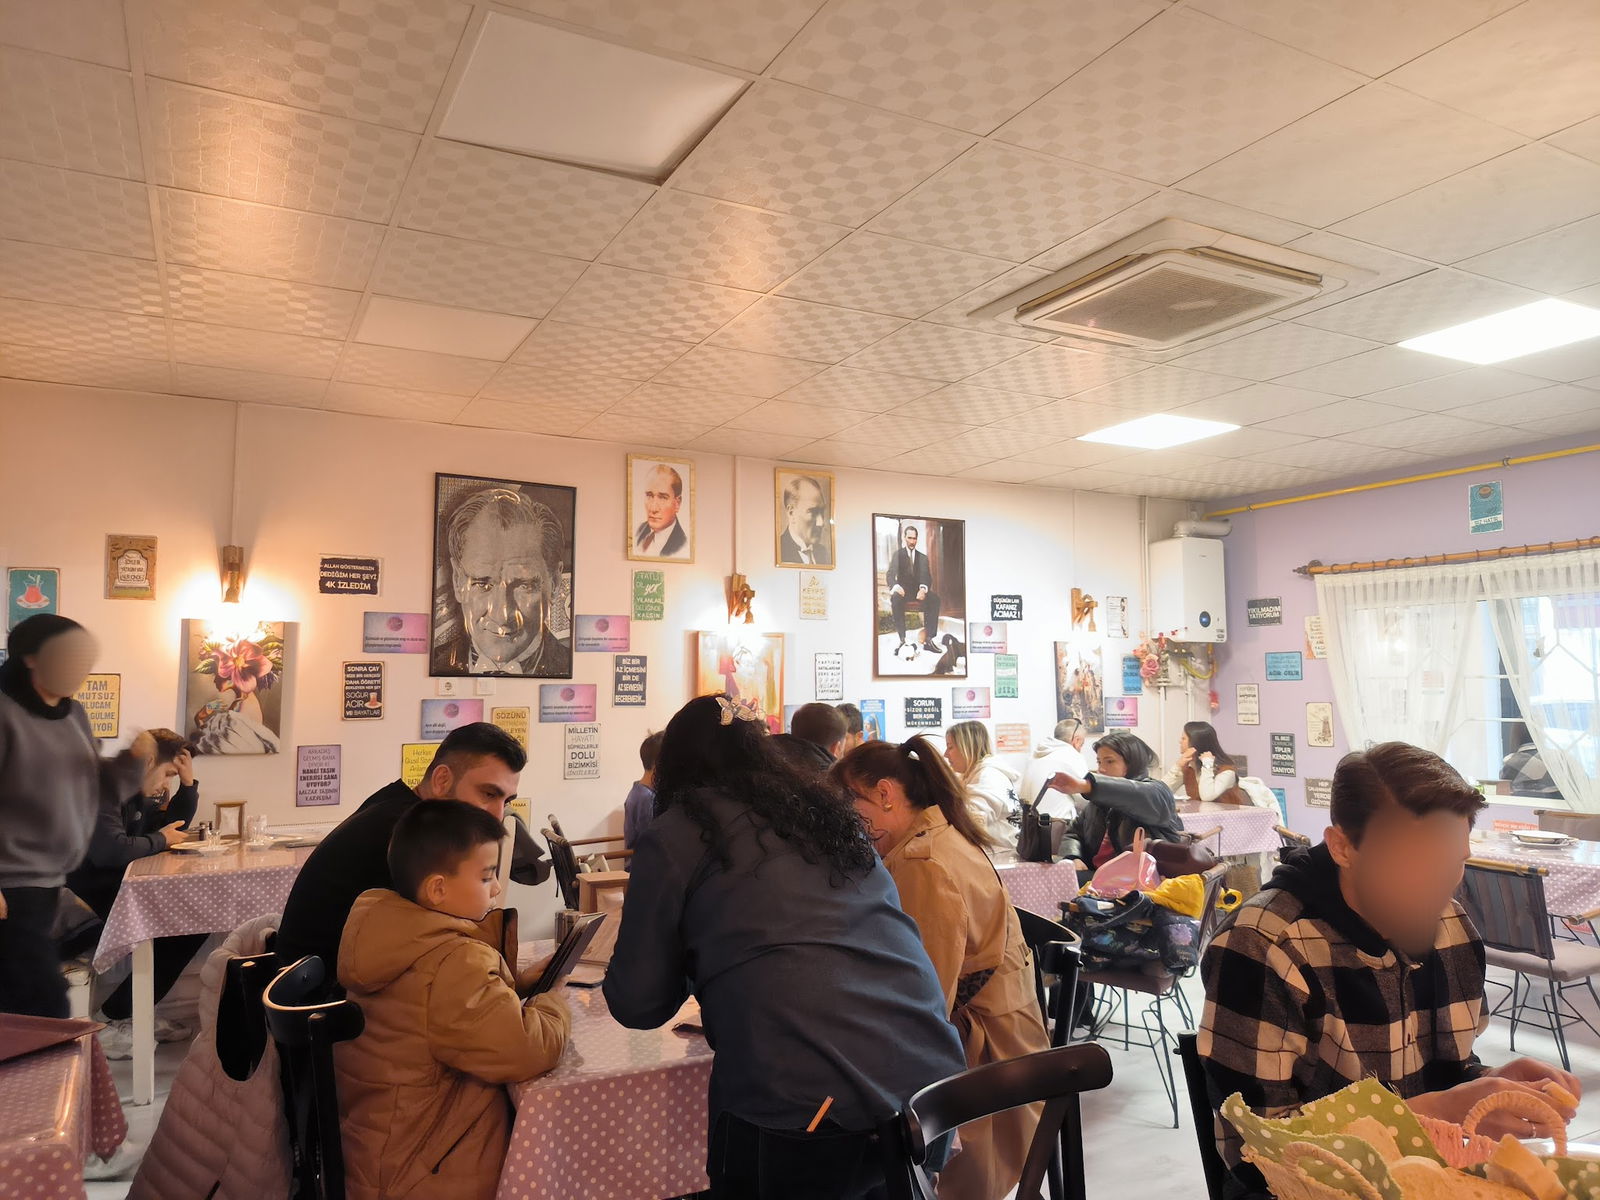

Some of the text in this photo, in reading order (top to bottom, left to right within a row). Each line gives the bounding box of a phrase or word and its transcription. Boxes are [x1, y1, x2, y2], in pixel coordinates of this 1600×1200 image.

[337, 581, 371, 590] İZLEDİM
[86, 681, 107, 690] TAM
[624, 682, 643, 691] SEVMESİNİ
[346, 700, 364, 708] ACIR
[571, 752, 595, 760] DOLU
